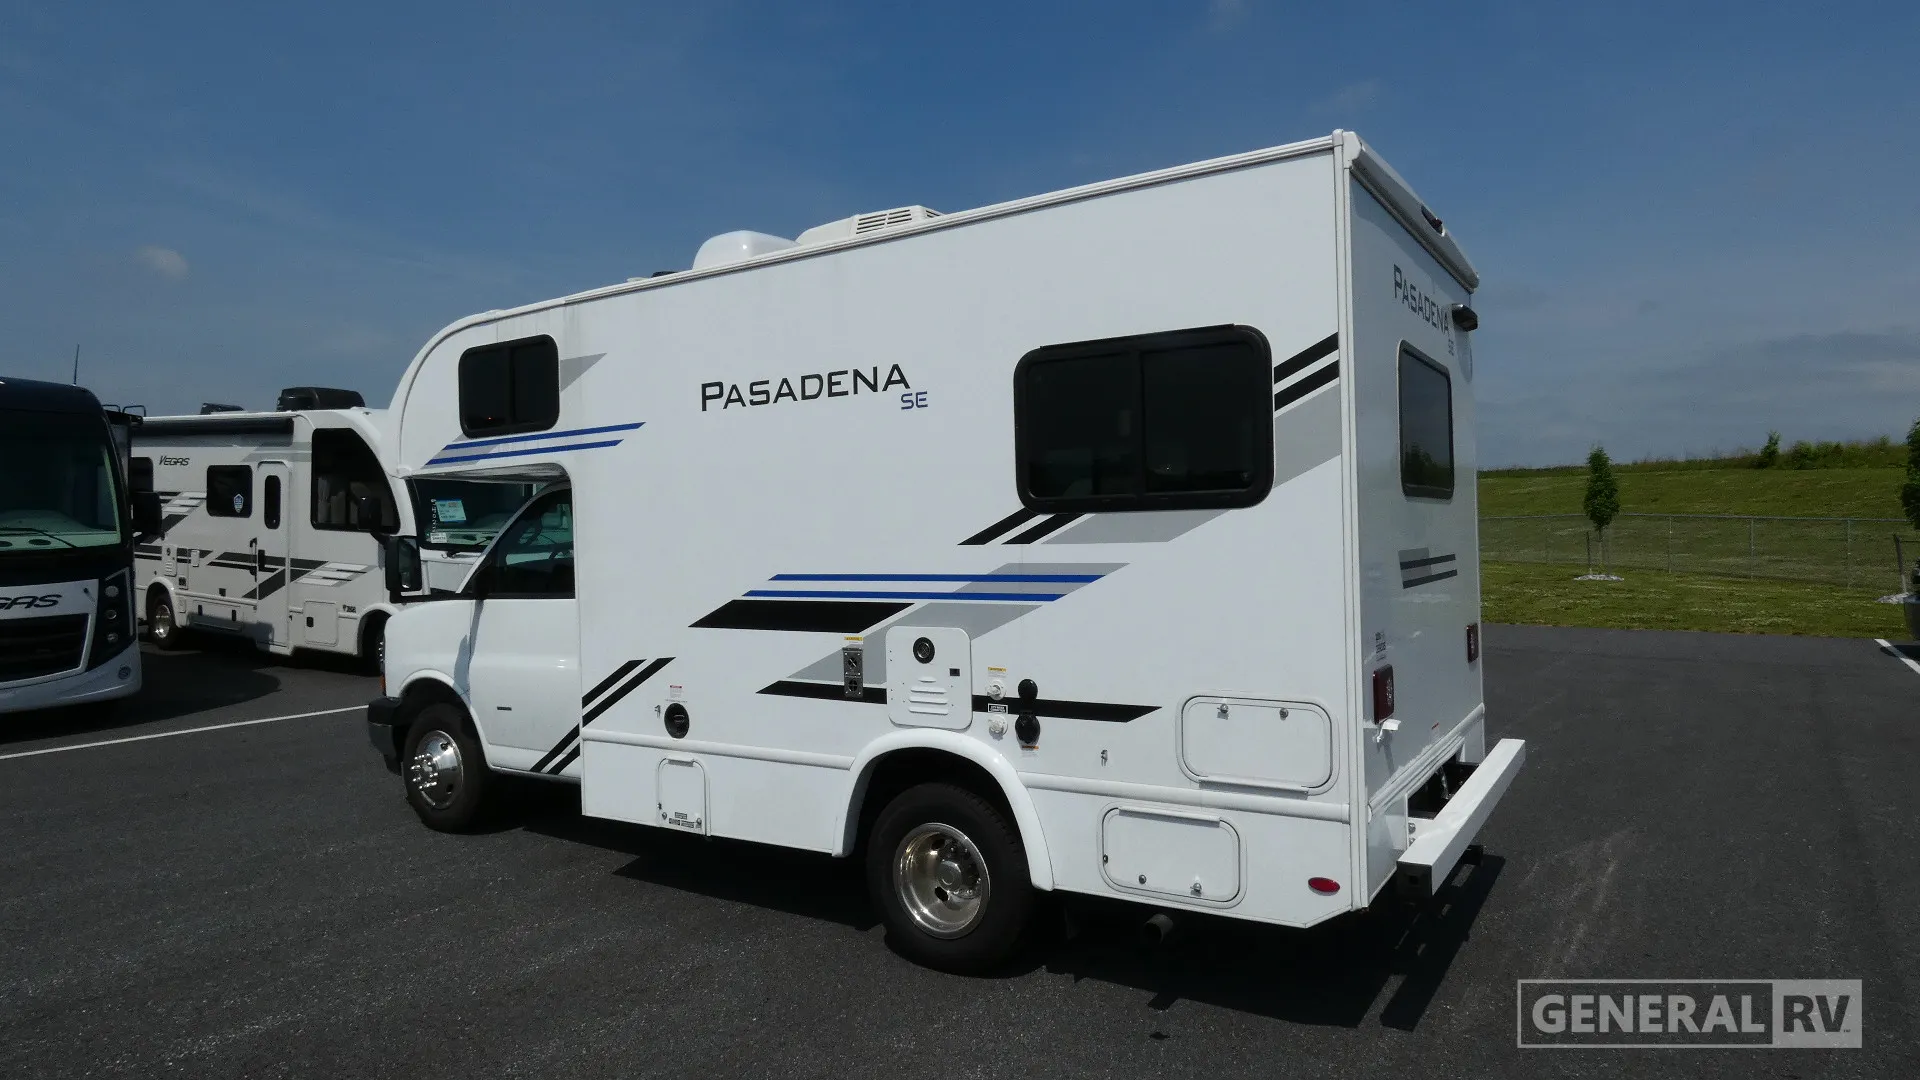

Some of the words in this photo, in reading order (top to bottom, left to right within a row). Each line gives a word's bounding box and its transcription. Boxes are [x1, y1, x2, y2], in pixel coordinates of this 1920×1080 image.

[1393, 263, 1450, 337] PASADENA
[701, 363, 911, 412] PASADENA
[900, 390, 929, 410] SE
[159, 455, 191, 467] VEGAS
